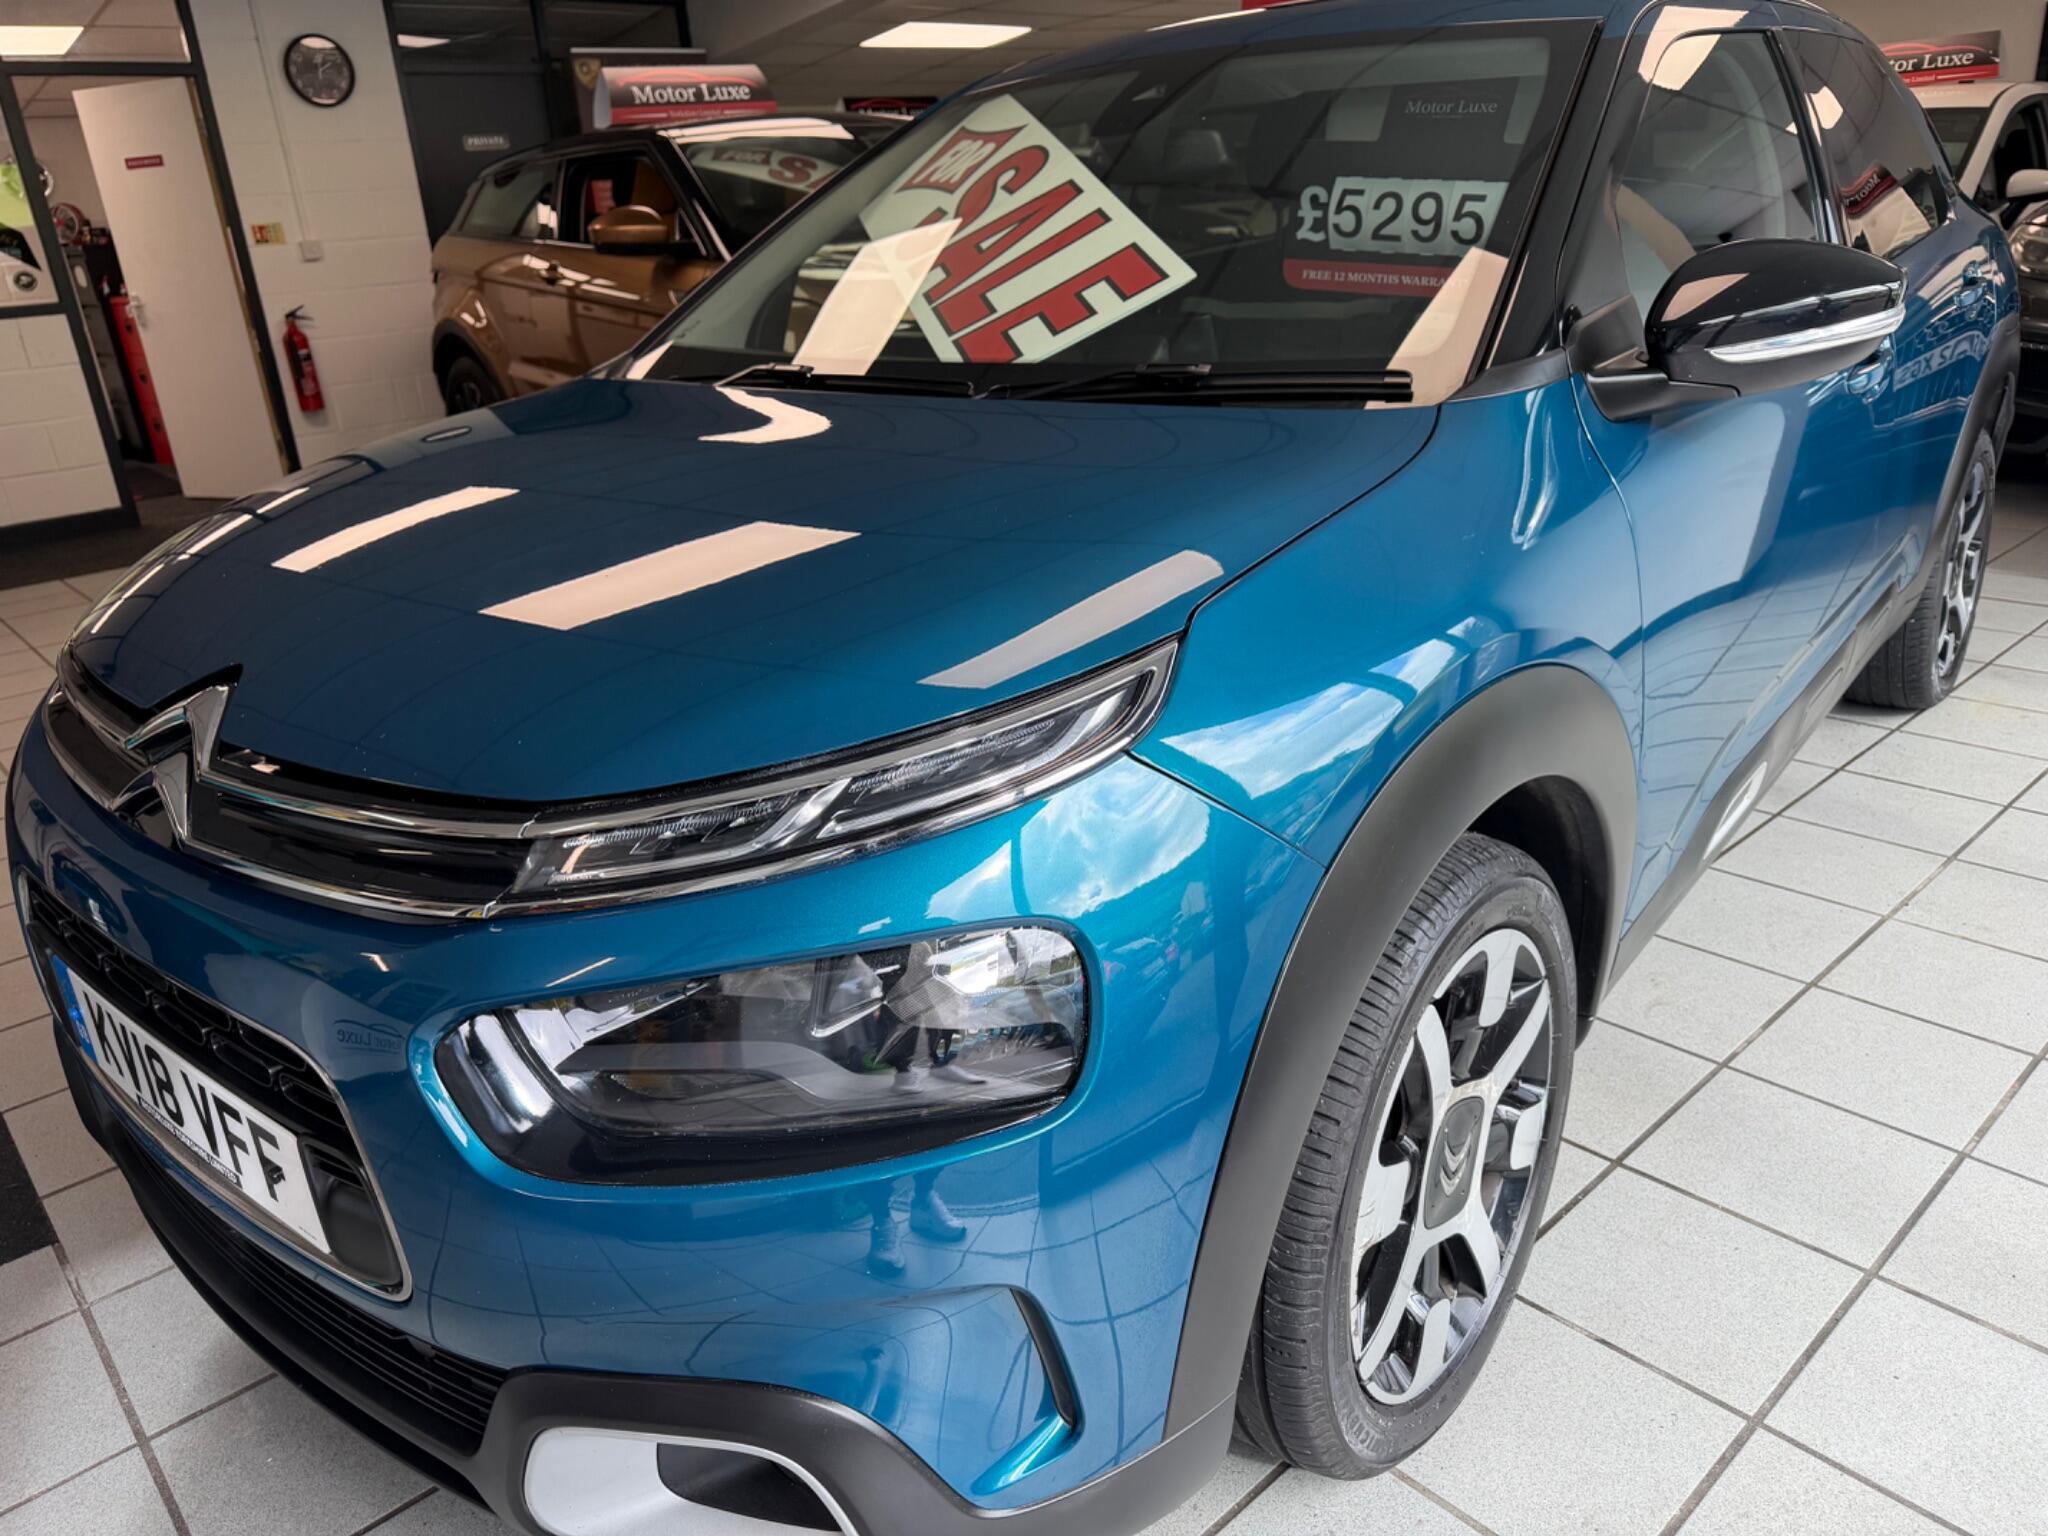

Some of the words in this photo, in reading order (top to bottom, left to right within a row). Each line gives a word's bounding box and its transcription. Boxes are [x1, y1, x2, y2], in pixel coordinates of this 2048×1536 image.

[1888, 58, 1918, 72] or
[1921, 52, 1975, 69] Luxe
[631, 85, 697, 105] Motor
[700, 83, 752, 102] Luxe
[1405, 100, 1455, 114] Motor
[1458, 99, 1498, 113] Luxe
[912, 137, 997, 185] FOR
[1296, 184, 1488, 246] £5295
[913, 143, 1170, 364] SALE
[1302, 269, 1332, 281] FREE
[1334, 271, 1346, 282] 12
[1348, 271, 1400, 286] MONTHS
[1402, 274, 1464, 288] WARRA
[83, 990, 184, 1128] KV18
[179, 1068, 281, 1203] VFF
